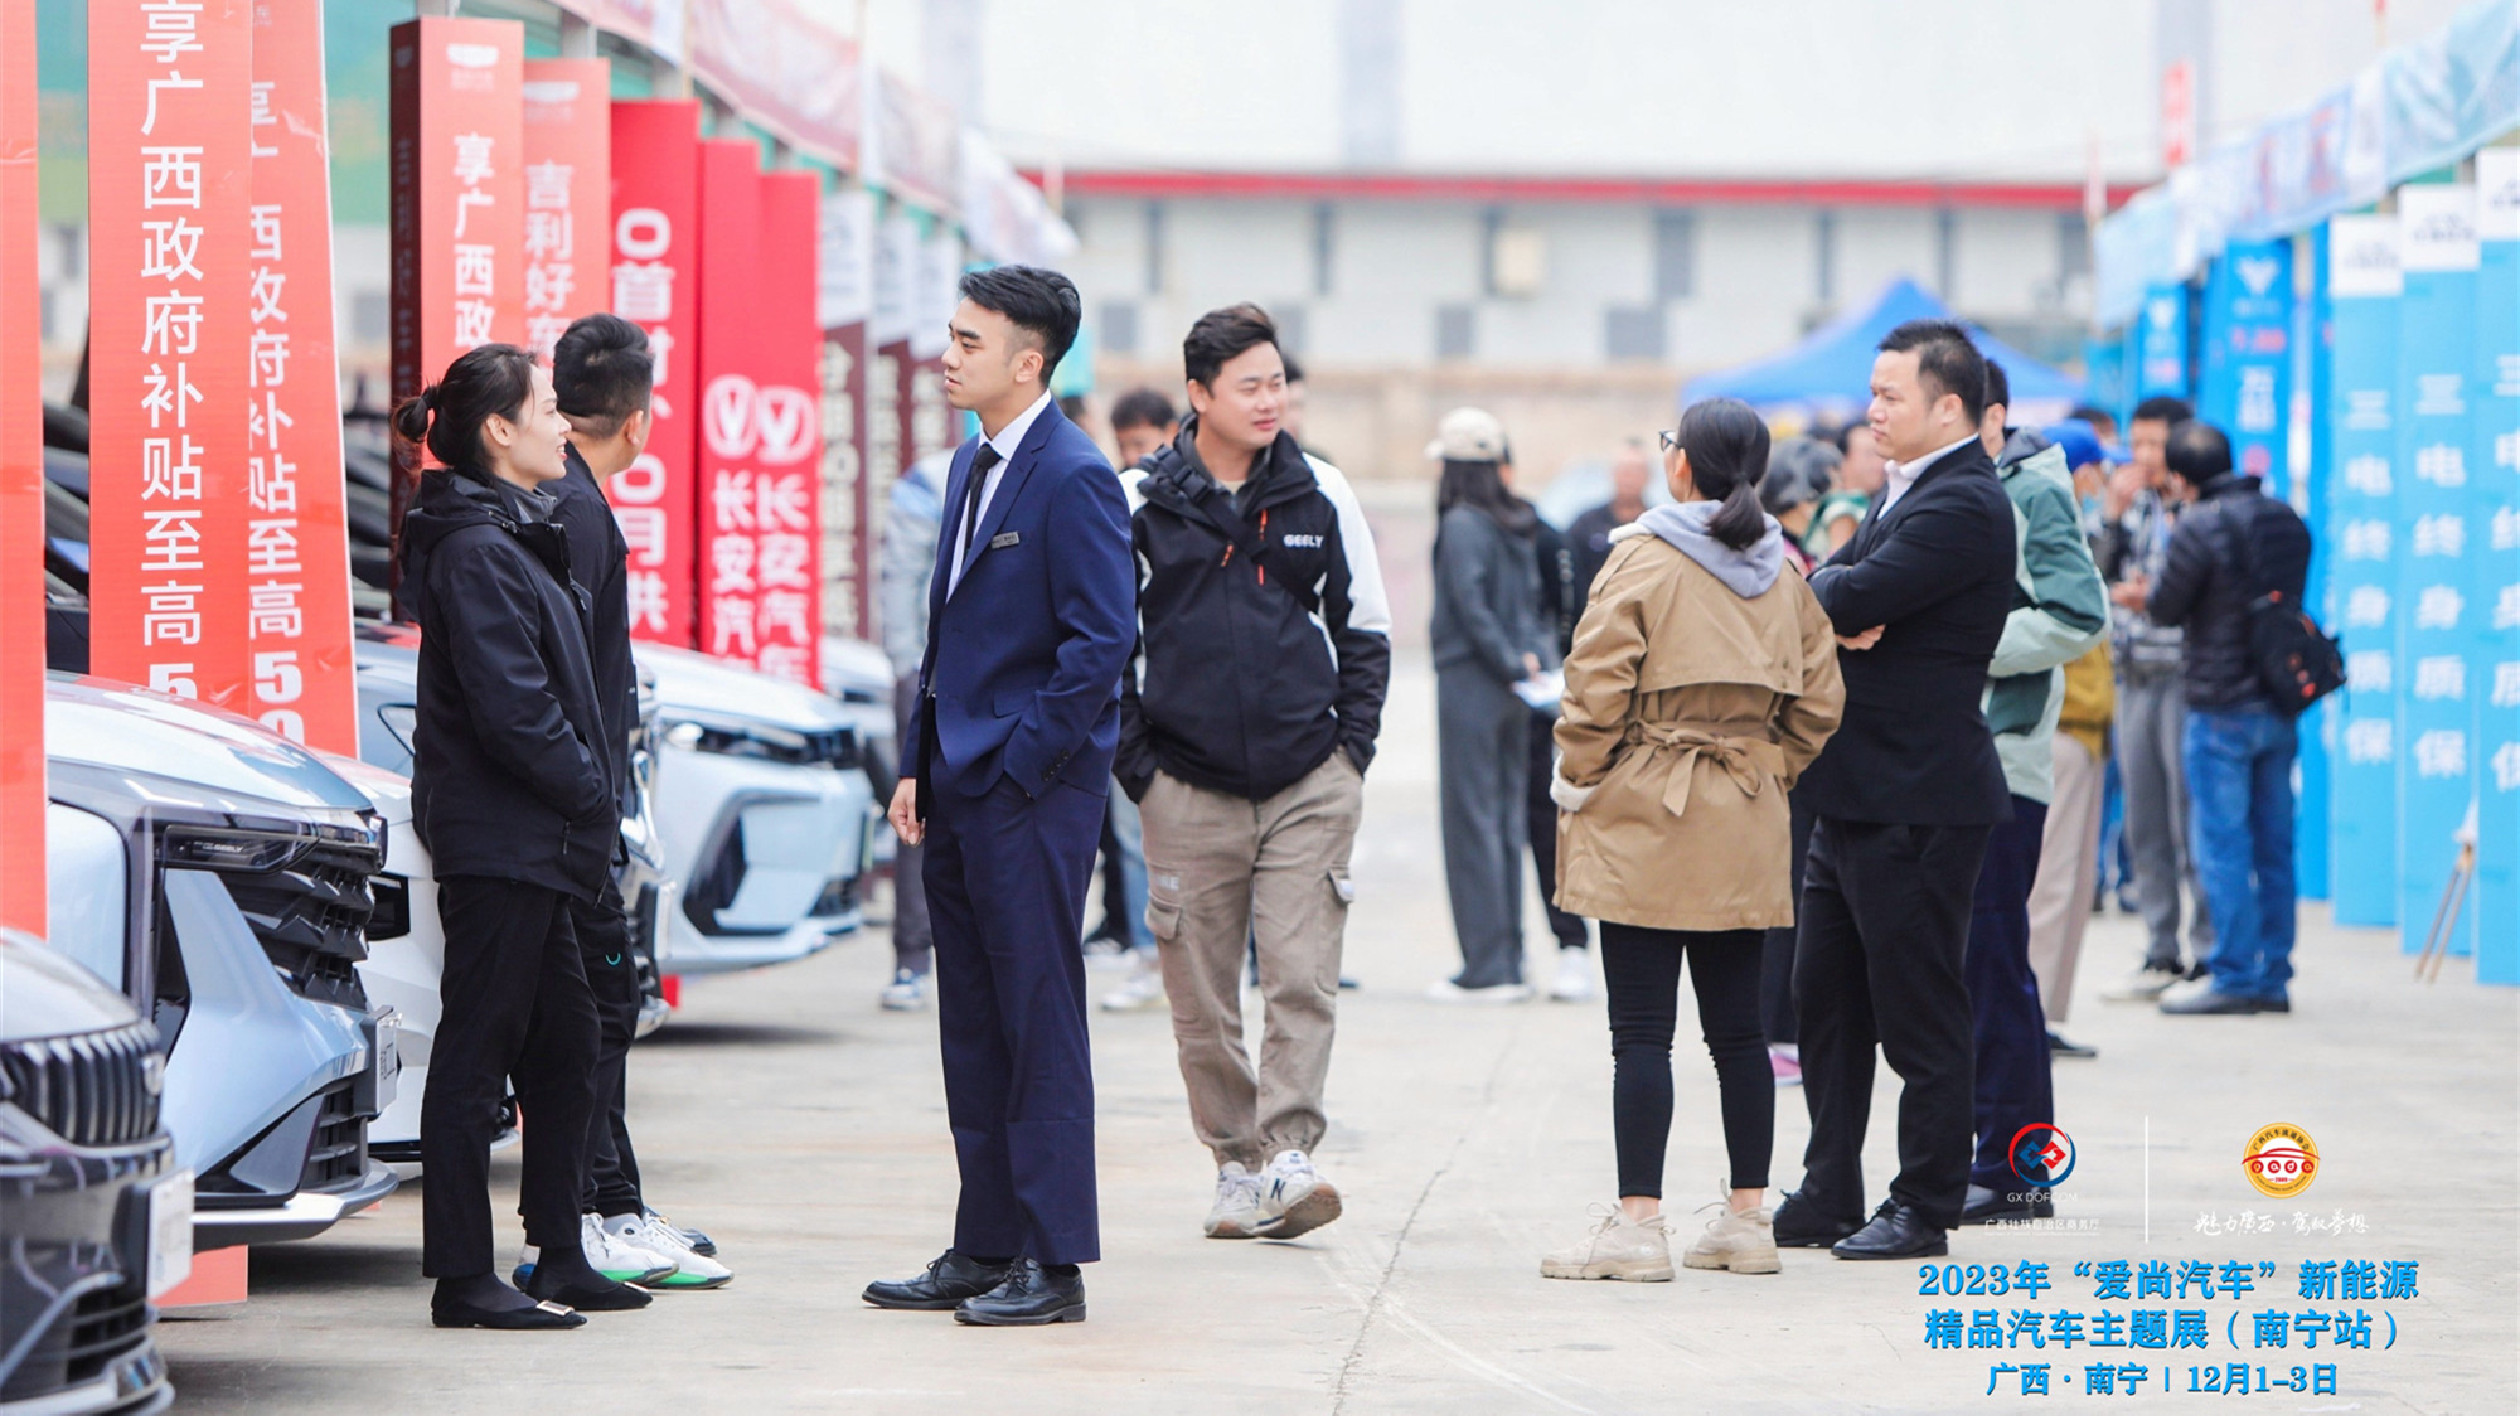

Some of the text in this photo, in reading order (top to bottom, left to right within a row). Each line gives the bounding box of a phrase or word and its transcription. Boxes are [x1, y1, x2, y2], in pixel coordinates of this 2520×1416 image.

[454, 132, 495, 348] 享广西政
[711, 469, 756, 669] 长安汽
[1283, 533, 1324, 548] GEELY
